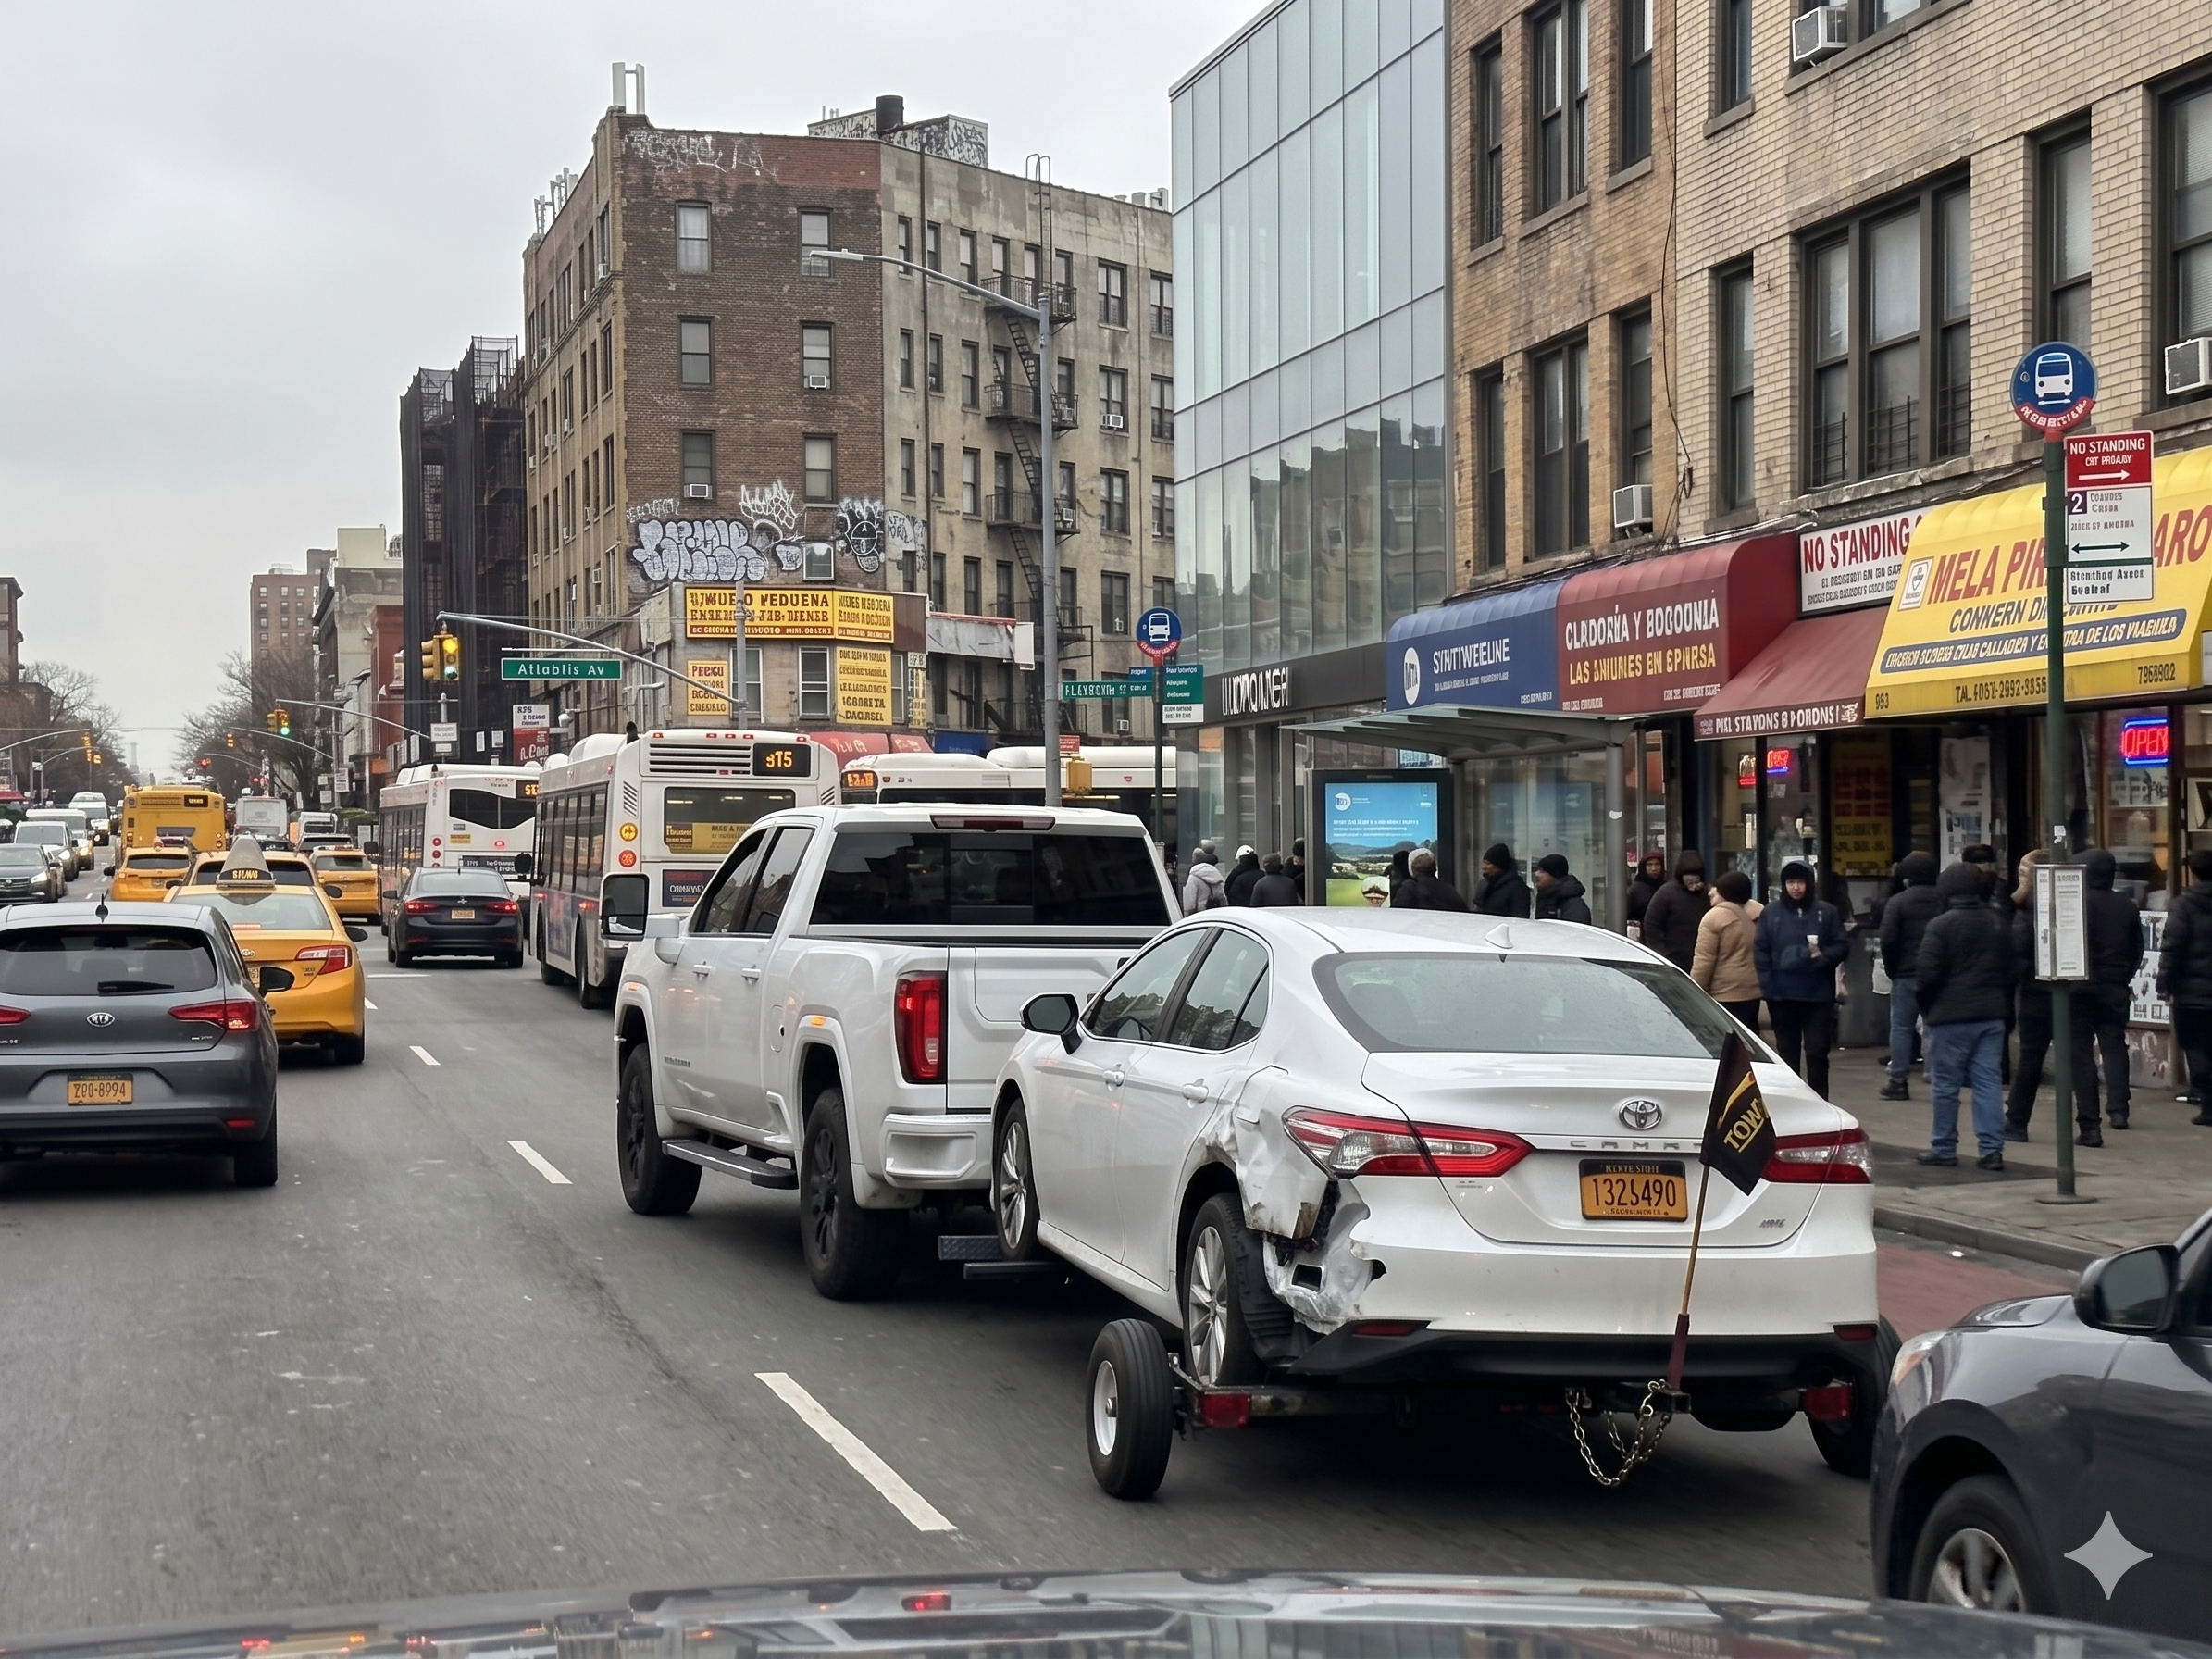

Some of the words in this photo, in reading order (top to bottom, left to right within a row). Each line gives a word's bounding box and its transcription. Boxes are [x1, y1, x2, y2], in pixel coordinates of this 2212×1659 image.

[2069, 442, 2086, 455] NO
[2089, 438, 2145, 454] STANDING
[2071, 493, 2082, 513] 2
[1803, 536, 1824, 574] NO
[1830, 517, 1910, 568] STANDING
[1927, 545, 2000, 605] MELA
[1633, 610, 1642, 640] Y
[2085, 626, 2102, 644] DE
[2102, 623, 2126, 642] LOS
[587, 665, 604, 675] Av
[1570, 660, 1590, 685] LAS
